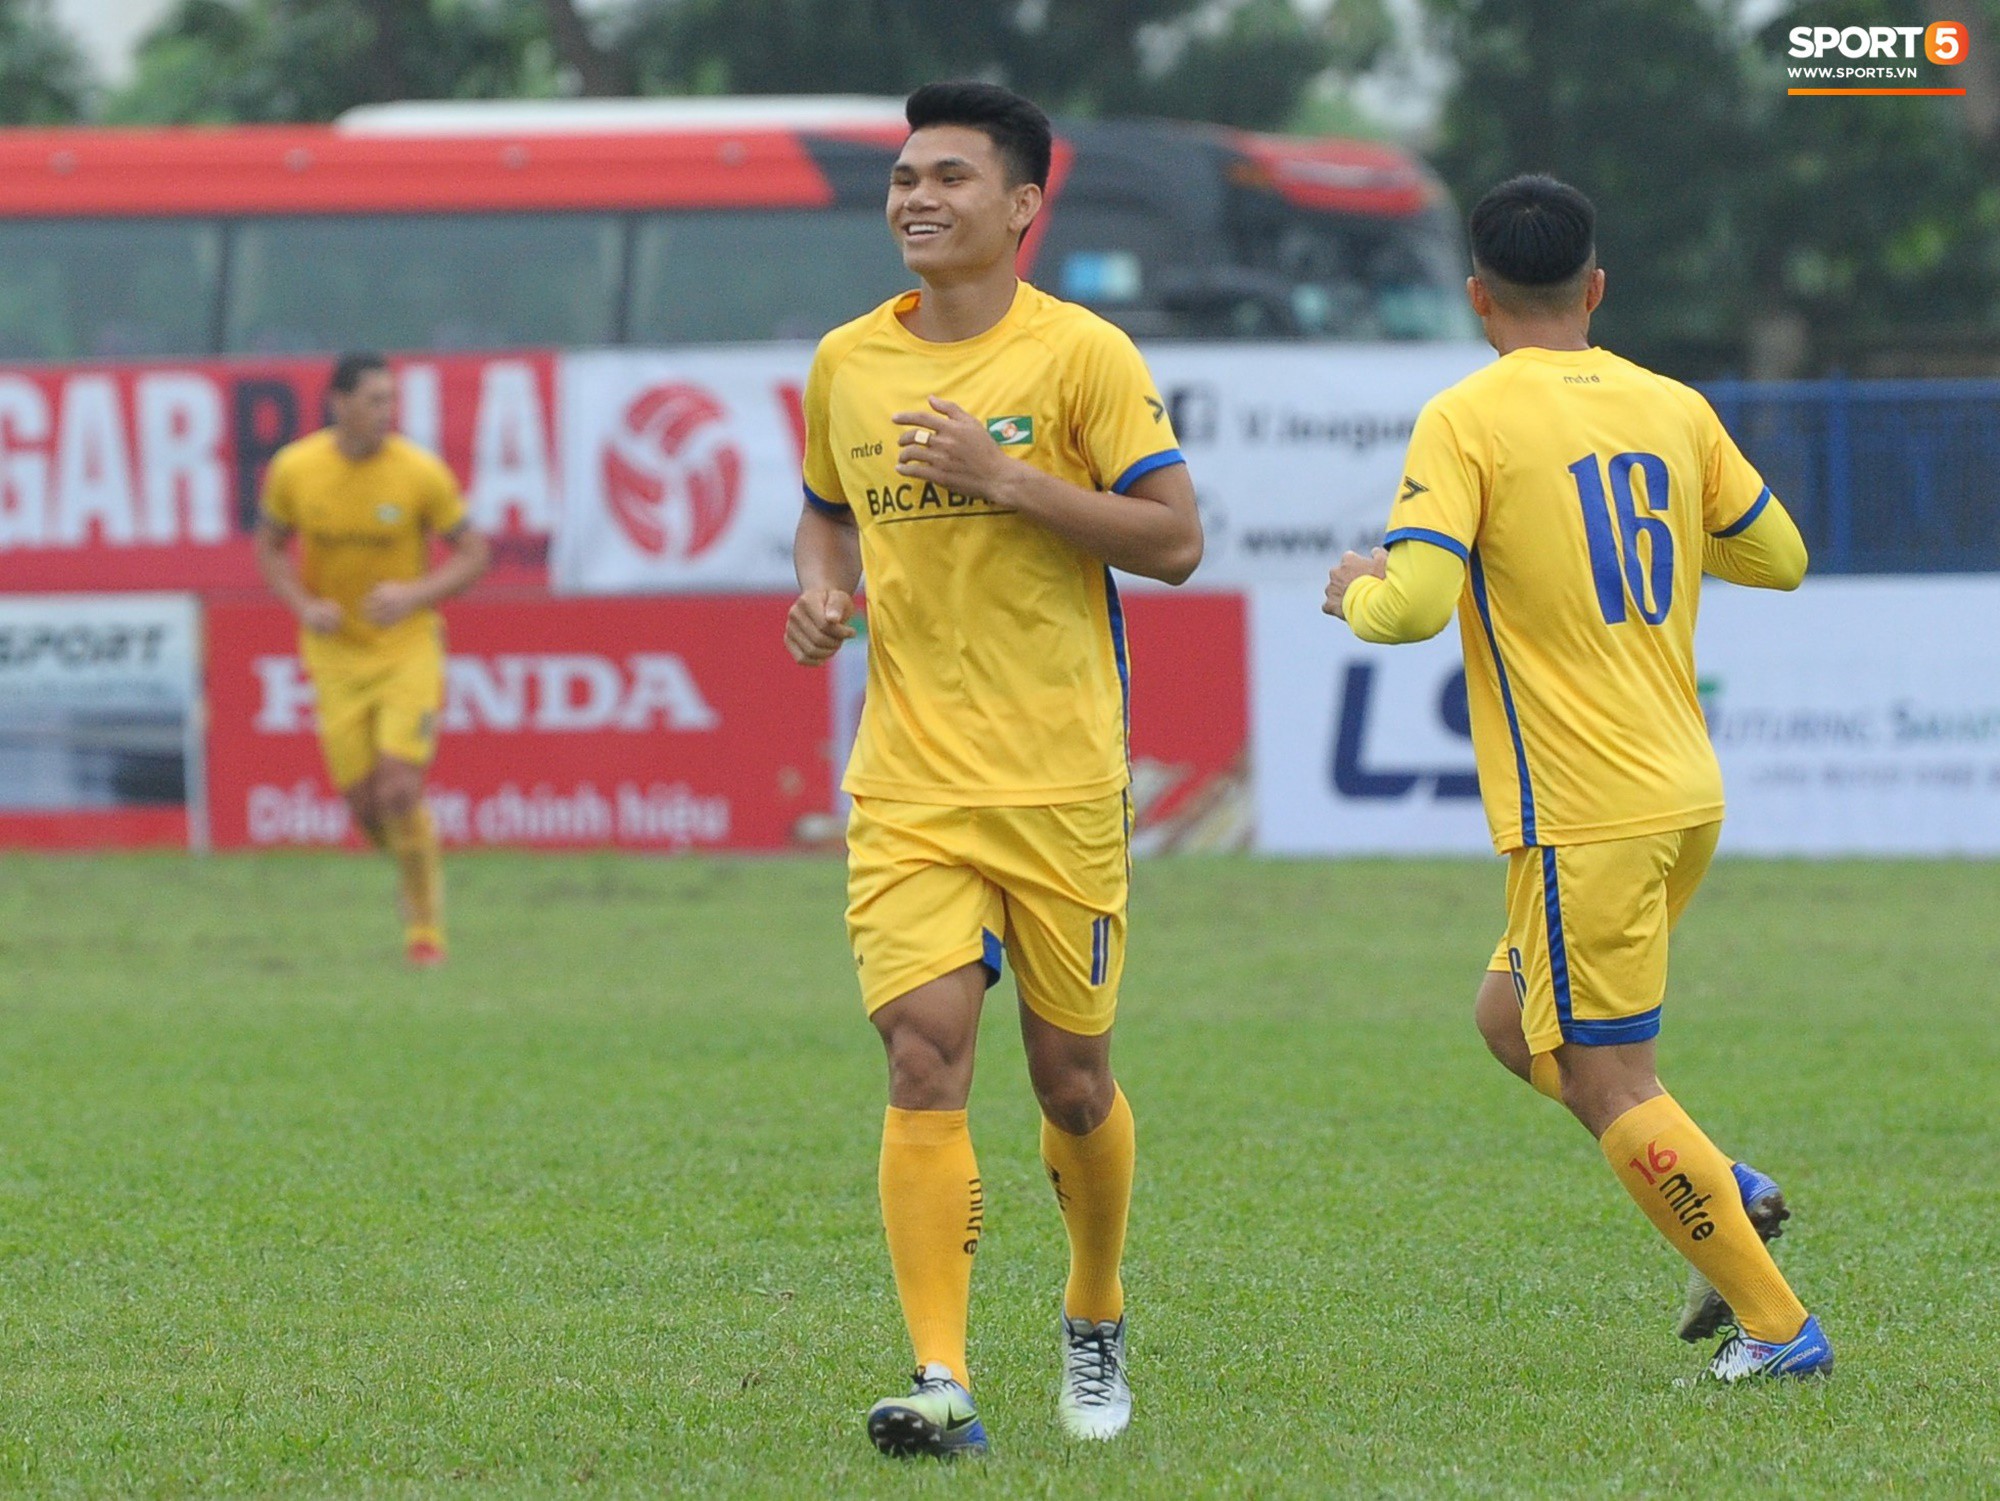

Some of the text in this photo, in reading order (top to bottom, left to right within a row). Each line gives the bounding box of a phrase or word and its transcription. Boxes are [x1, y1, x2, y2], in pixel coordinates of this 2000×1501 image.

[851, 440, 883, 460] mitre
[866, 482, 914, 517] BAC
[1567, 452, 1674, 626] 16
[254, 653, 720, 734] HNDA
[1090, 914, 1112, 986] 11
[1628, 1140, 1678, 1186] 16
[1658, 1172, 1716, 1242] mitre
